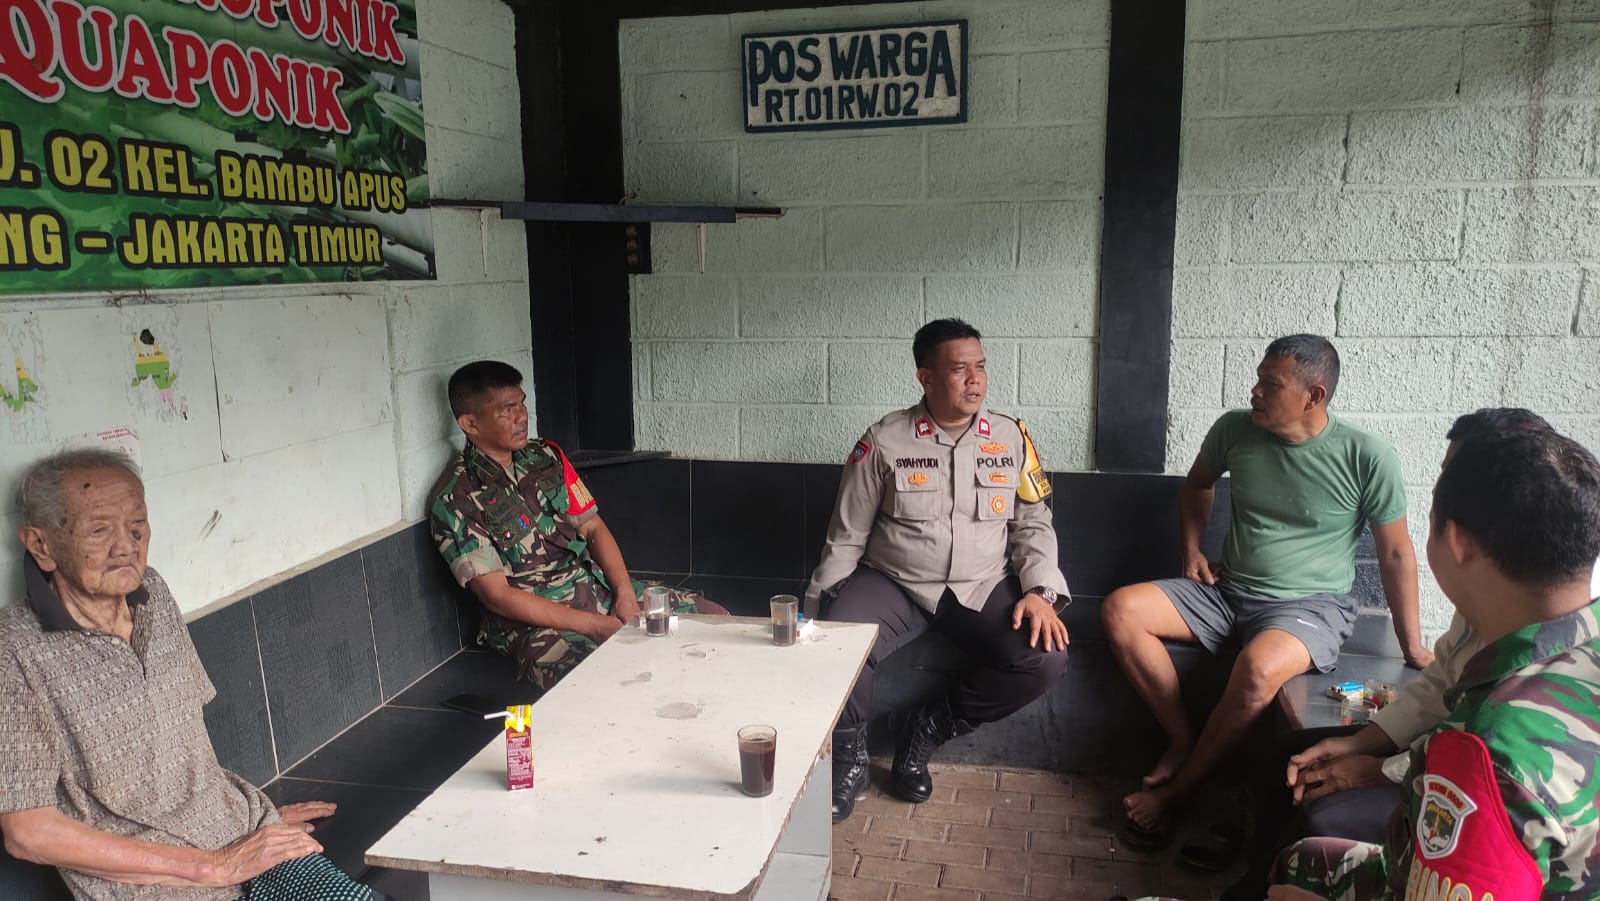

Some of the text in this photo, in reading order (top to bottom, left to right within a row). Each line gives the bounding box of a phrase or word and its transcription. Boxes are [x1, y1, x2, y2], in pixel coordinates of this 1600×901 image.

[750, 30, 957, 107] POS WARGA
[50, 136, 112, 190] 02
[124, 143, 209, 196] KEL.
[220, 155, 334, 205] BAMBU
[343, 171, 406, 209] APUS
[123, 218, 285, 264] JAKARTA
[293, 225, 381, 263] TIMUR
[896, 457, 939, 469] SYAHYUDI
[976, 457, 1014, 469] POLRI
